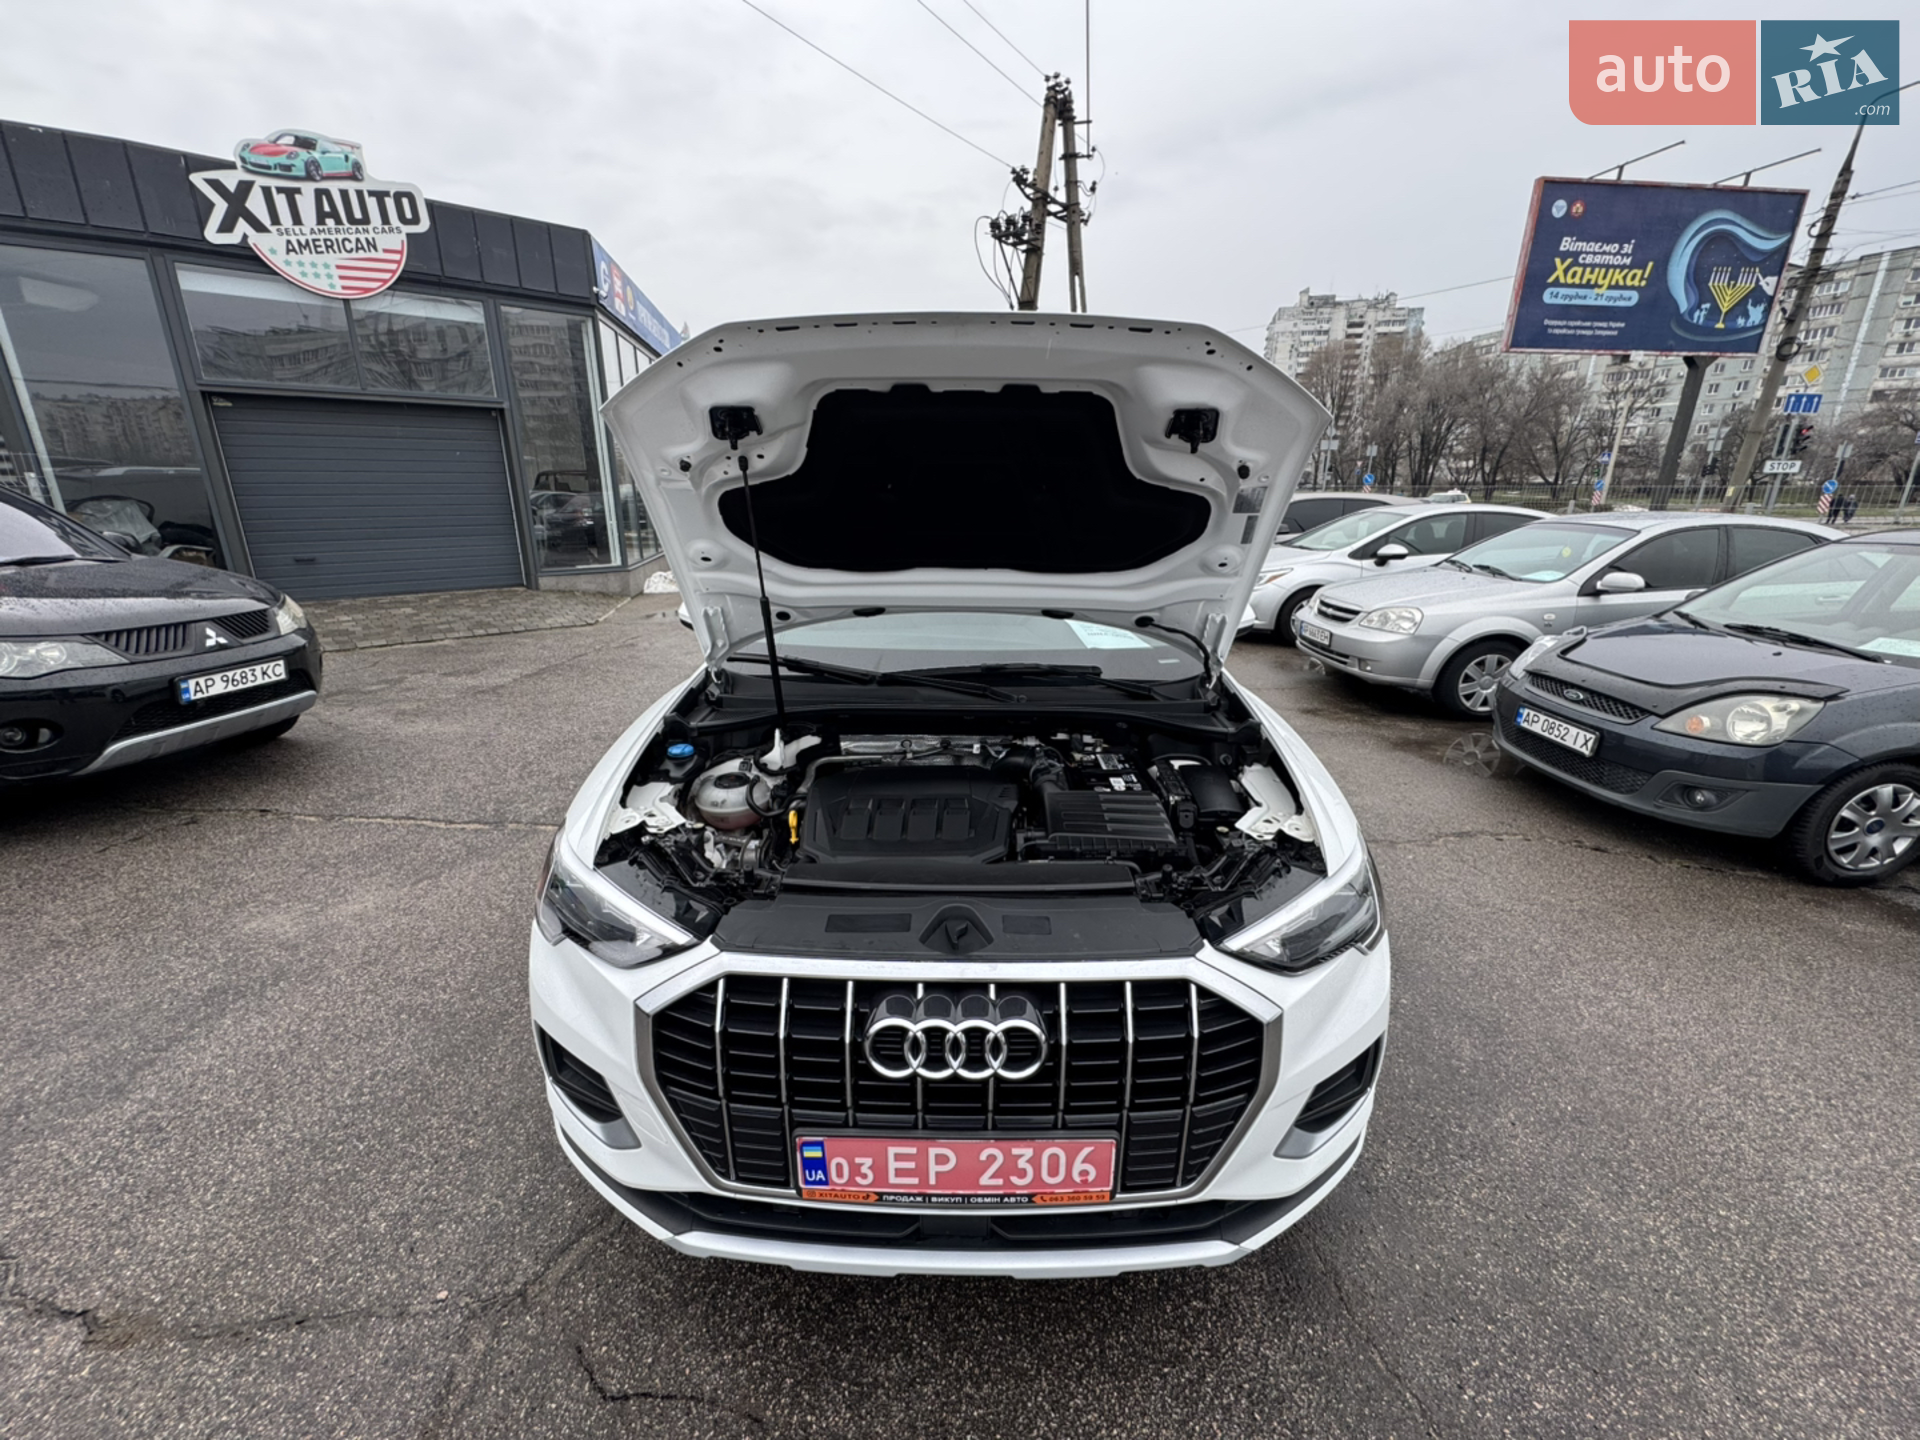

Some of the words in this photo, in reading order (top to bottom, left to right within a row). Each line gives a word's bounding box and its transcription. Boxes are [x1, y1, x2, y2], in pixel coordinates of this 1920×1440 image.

[202, 178, 306, 234] XIT
[313, 187, 422, 226] AUTO
[276, 227, 307, 236] SELL
[309, 226, 370, 236] AMERICAN
[372, 226, 403, 235] CARS
[285, 237, 379, 255] AMERICAN
[1559, 236, 1620, 254] Вітаємо
[1620, 239, 1635, 254] зі
[1578, 253, 1633, 265] святом
[1546, 257, 1654, 293] Ханука!
[1768, 462, 1797, 471] STOP
[193, 677, 216, 697] AP
[220, 668, 258, 690] 9683
[260, 663, 283, 681] KC
[1522, 711, 1540, 727] AP
[1540, 718, 1570, 742] 0852
[829, 1156, 874, 1185] 03
[887, 1146, 957, 1185] EP
[978, 1146, 1097, 1186] 2306
[805, 1169, 826, 1182] UA
[818, 1192, 861, 1200] XITAUTO
[882, 1194, 924, 1202] ПРОДАЖ
[969, 1196, 1000, 1204] ОБМІН
